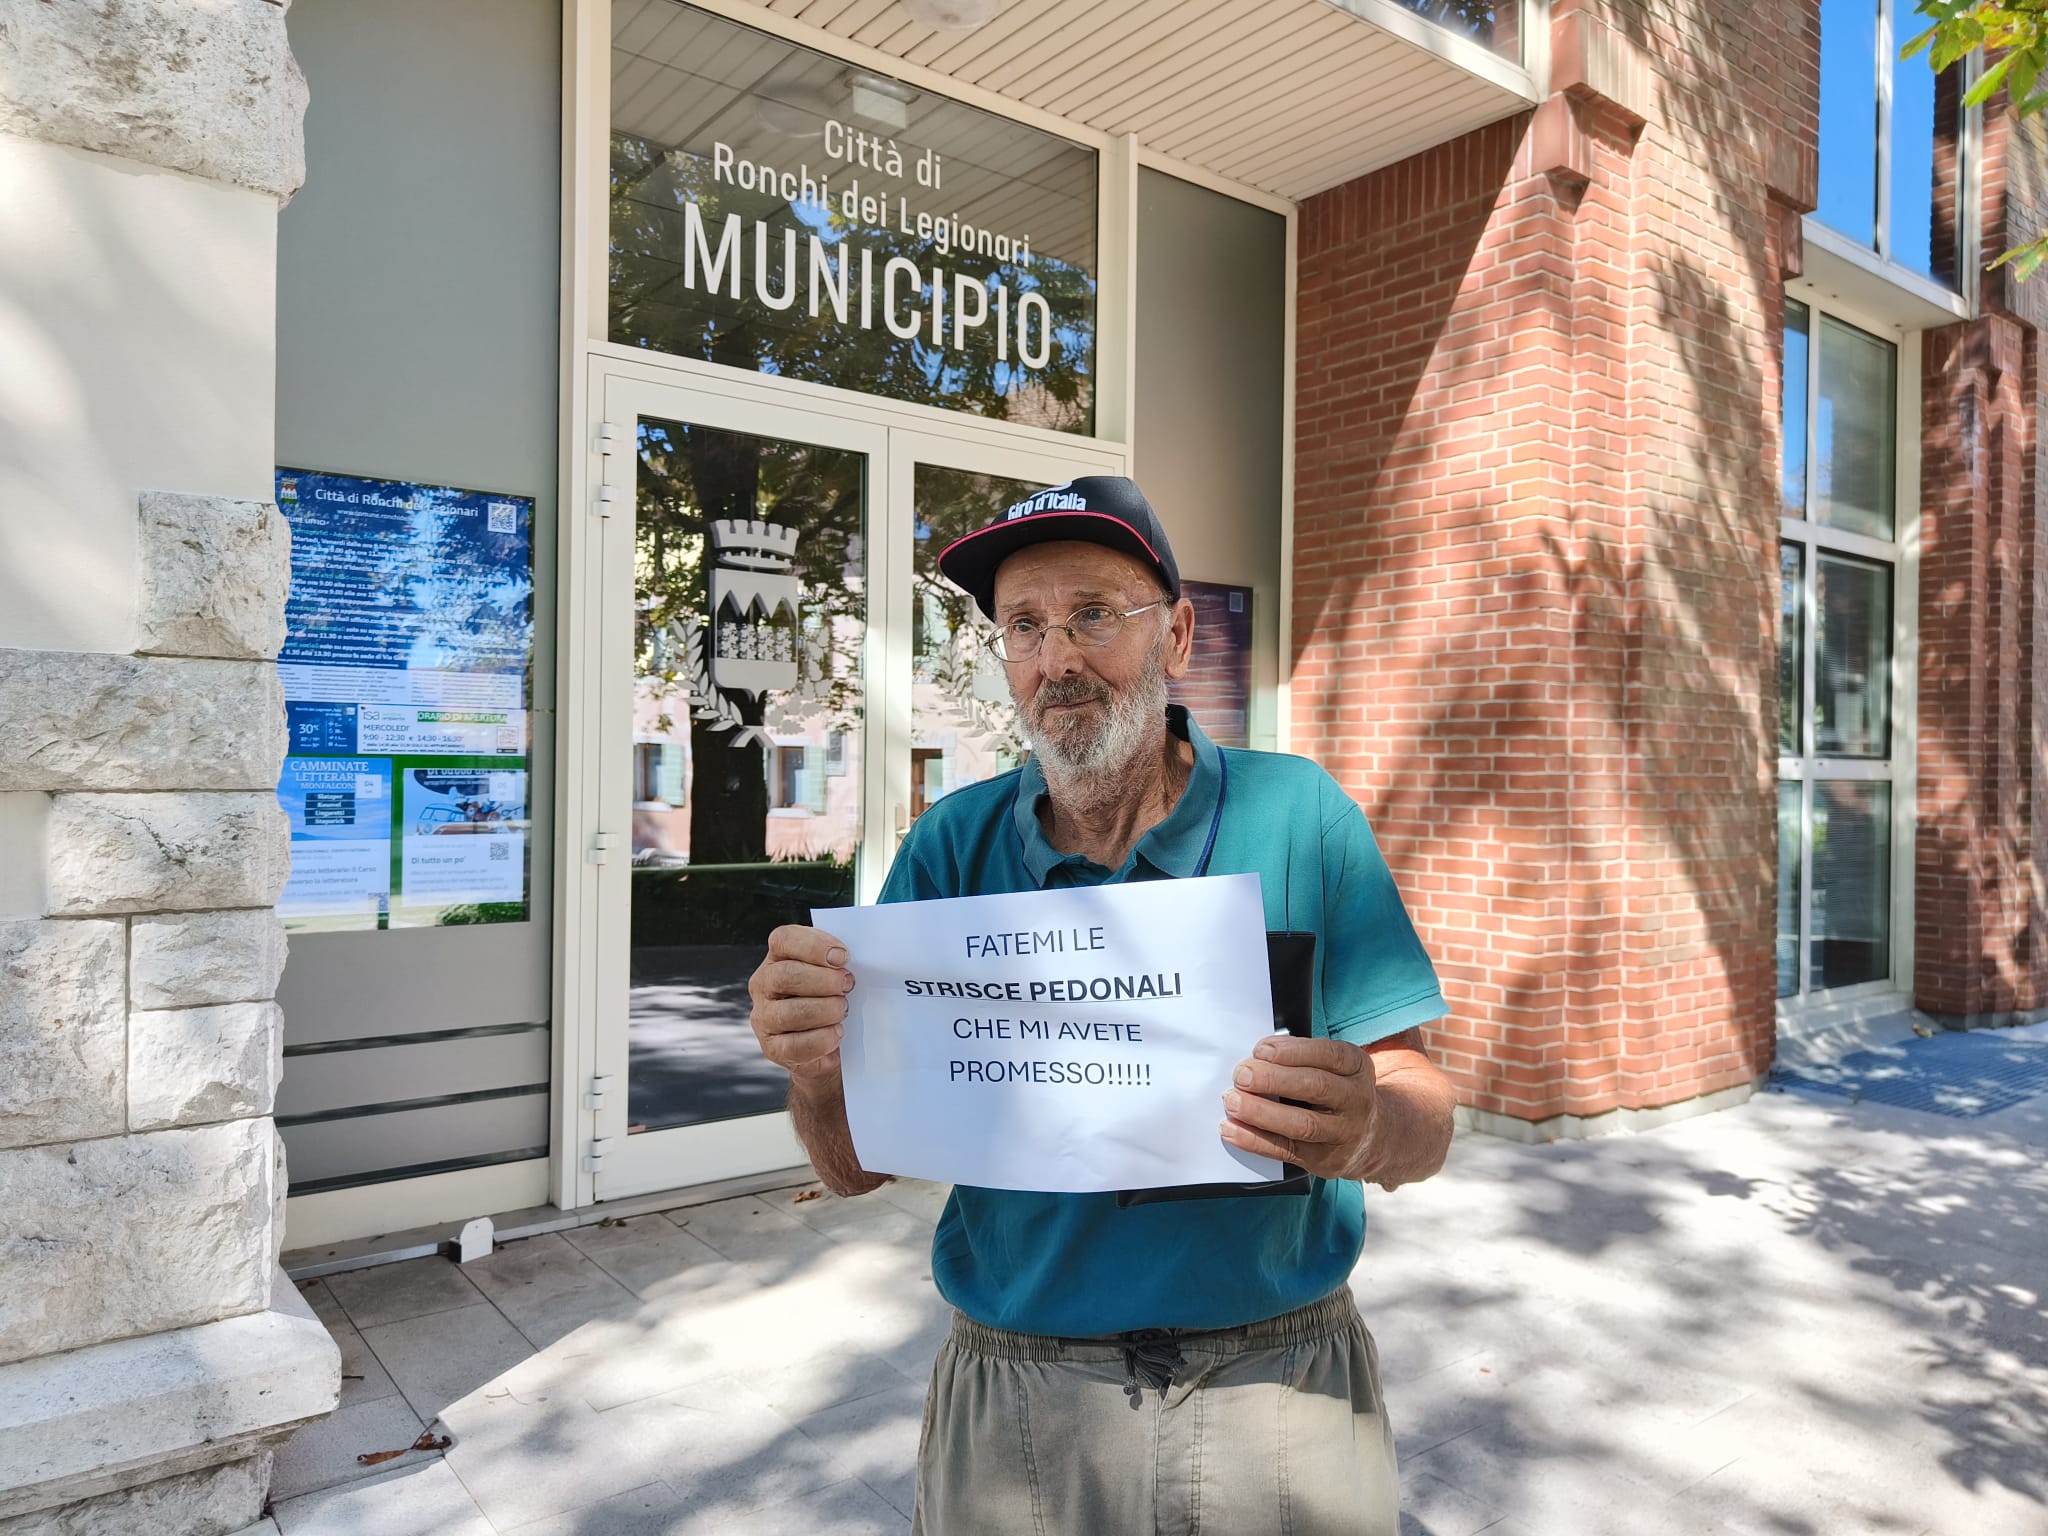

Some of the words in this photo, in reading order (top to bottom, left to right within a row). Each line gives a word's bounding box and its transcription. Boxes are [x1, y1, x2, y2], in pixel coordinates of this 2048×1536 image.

[824, 119, 903, 178] Città
[916, 148, 941, 190] di
[714, 141, 828, 210] Ronchi
[842, 179, 887, 228] dei
[900, 197, 1030, 268] Legionari
[684, 201, 1051, 369] MUNICIPIO
[315, 489, 345, 502] Città
[347, 493, 359, 504] di
[1007, 500, 1033, 520] Giro
[1034, 492, 1087, 512] d'Italia
[418, 712, 451, 721] ORARIO
[290, 760, 369, 772] CAMMINATE
[295, 772, 363, 782] LETTERARI
[301, 782, 357, 790] MONFALCON
[966, 928, 1065, 958] FATEMI
[1073, 927, 1105, 951] LE
[904, 979, 1021, 1001] STRISCE
[1029, 972, 1182, 1002] PEDONALI
[953, 1018, 1012, 1040] CHE
[1019, 1020, 1049, 1040] MI
[1058, 1022, 1143, 1042] AVETE
[950, 1060, 1151, 1086] PROMESSO!!!!!
